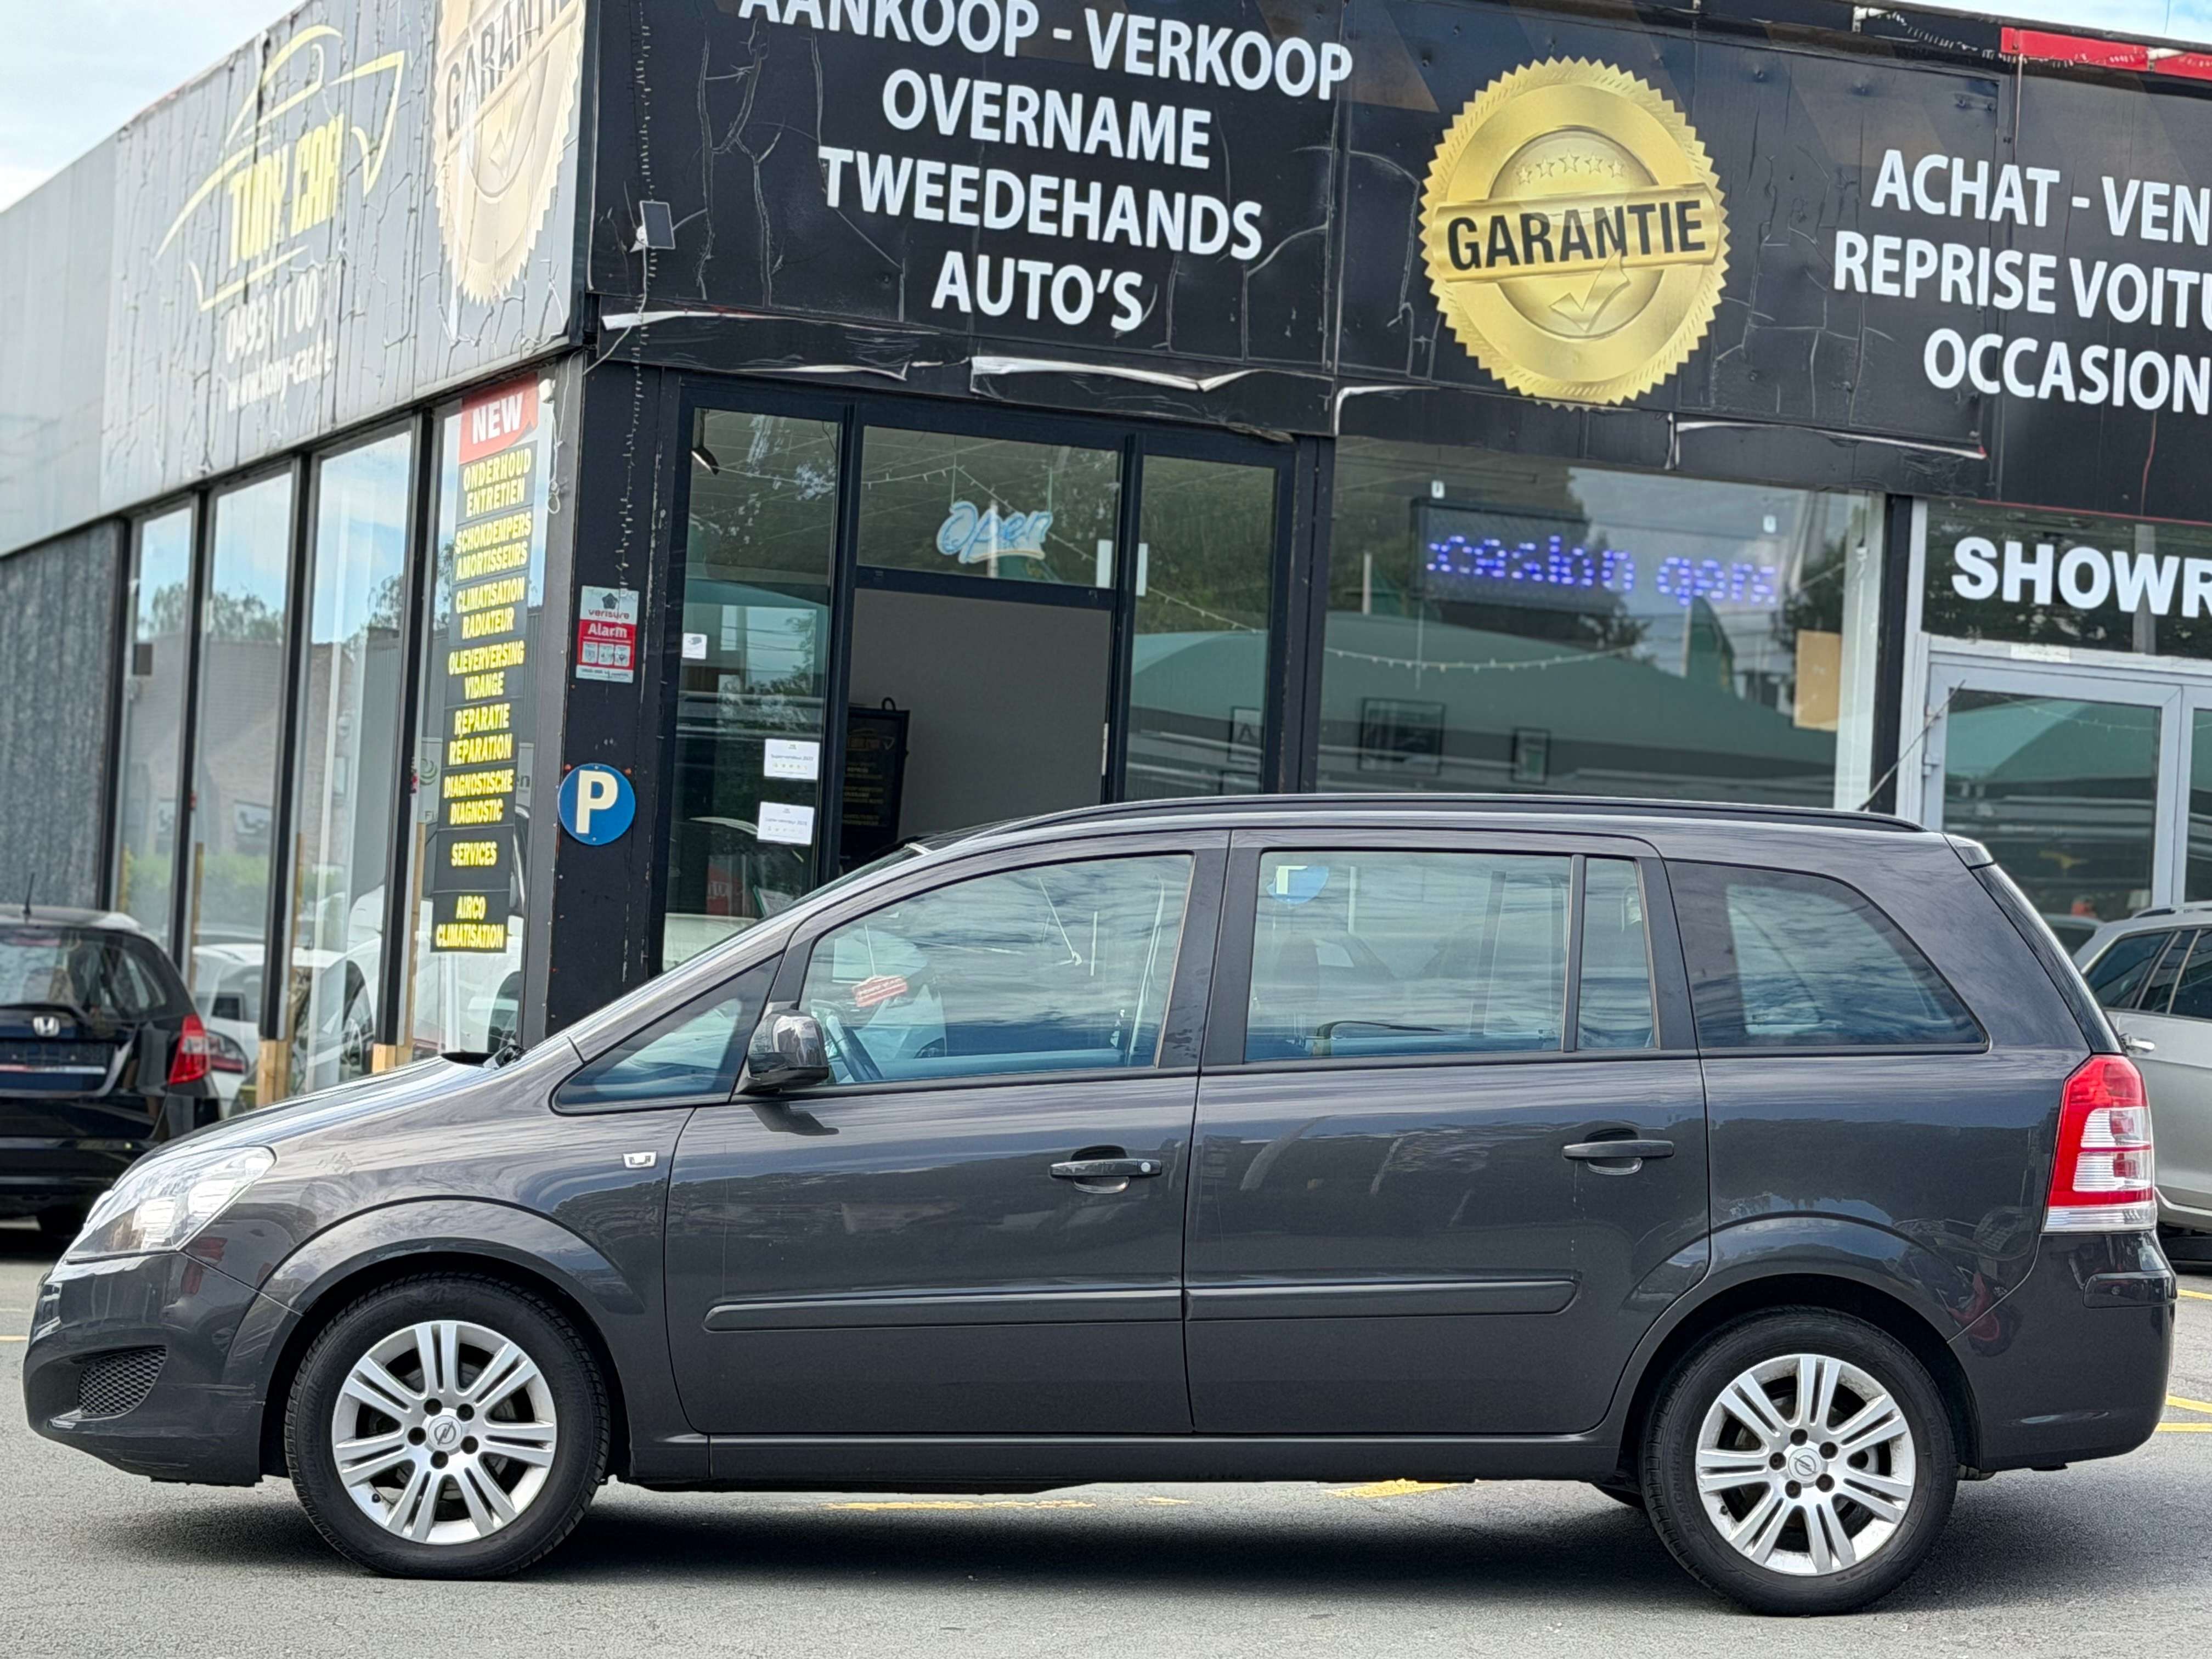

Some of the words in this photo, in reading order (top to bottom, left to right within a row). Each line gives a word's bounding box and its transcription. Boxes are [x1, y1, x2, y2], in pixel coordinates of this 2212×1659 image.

[446, 0, 571, 141] GARAN
[1085, 9, 1353, 100] VERKOOP
[883, 69, 1211, 169] OVERNAME
[290, 113, 345, 238] CAR
[818, 146, 1262, 260] TWEEDEHANDS
[1871, 149, 2060, 227] ACHAT
[2101, 176, 2211, 246] VEN
[1447, 199, 1705, 270] GARANTIE
[1834, 230, 2057, 314] REPRISE
[2069, 257, 2212, 331] VOIT
[1924, 329, 2211, 415] OCCASION
[472, 393, 523, 444] NEW
[463, 448, 532, 492] ONDERHOUD
[466, 478, 525, 517] ENTRETIEN
[454, 511, 532, 554] SCHOKDEMPERS
[936, 500, 1053, 564] Open
[456, 541, 528, 581] AMORTISSEURS
[456, 577, 525, 614] CLIMATISATION
[462, 607, 515, 639] RADIATEUR
[588, 623, 628, 638] Alarm
[448, 640, 524, 676] OLIEVERVERSING
[465, 671, 505, 700] VIDANGE
[454, 703, 511, 735] REPARATIE
[443, 769, 515, 799] DIAGNOSTISCHE
[576, 770, 618, 834] P
[449, 798, 504, 825] DIAGNOSTIC
[451, 842, 498, 867] SERVICES
[456, 896, 487, 919] AIRCO
[436, 924, 505, 949] CLIMATISATION
